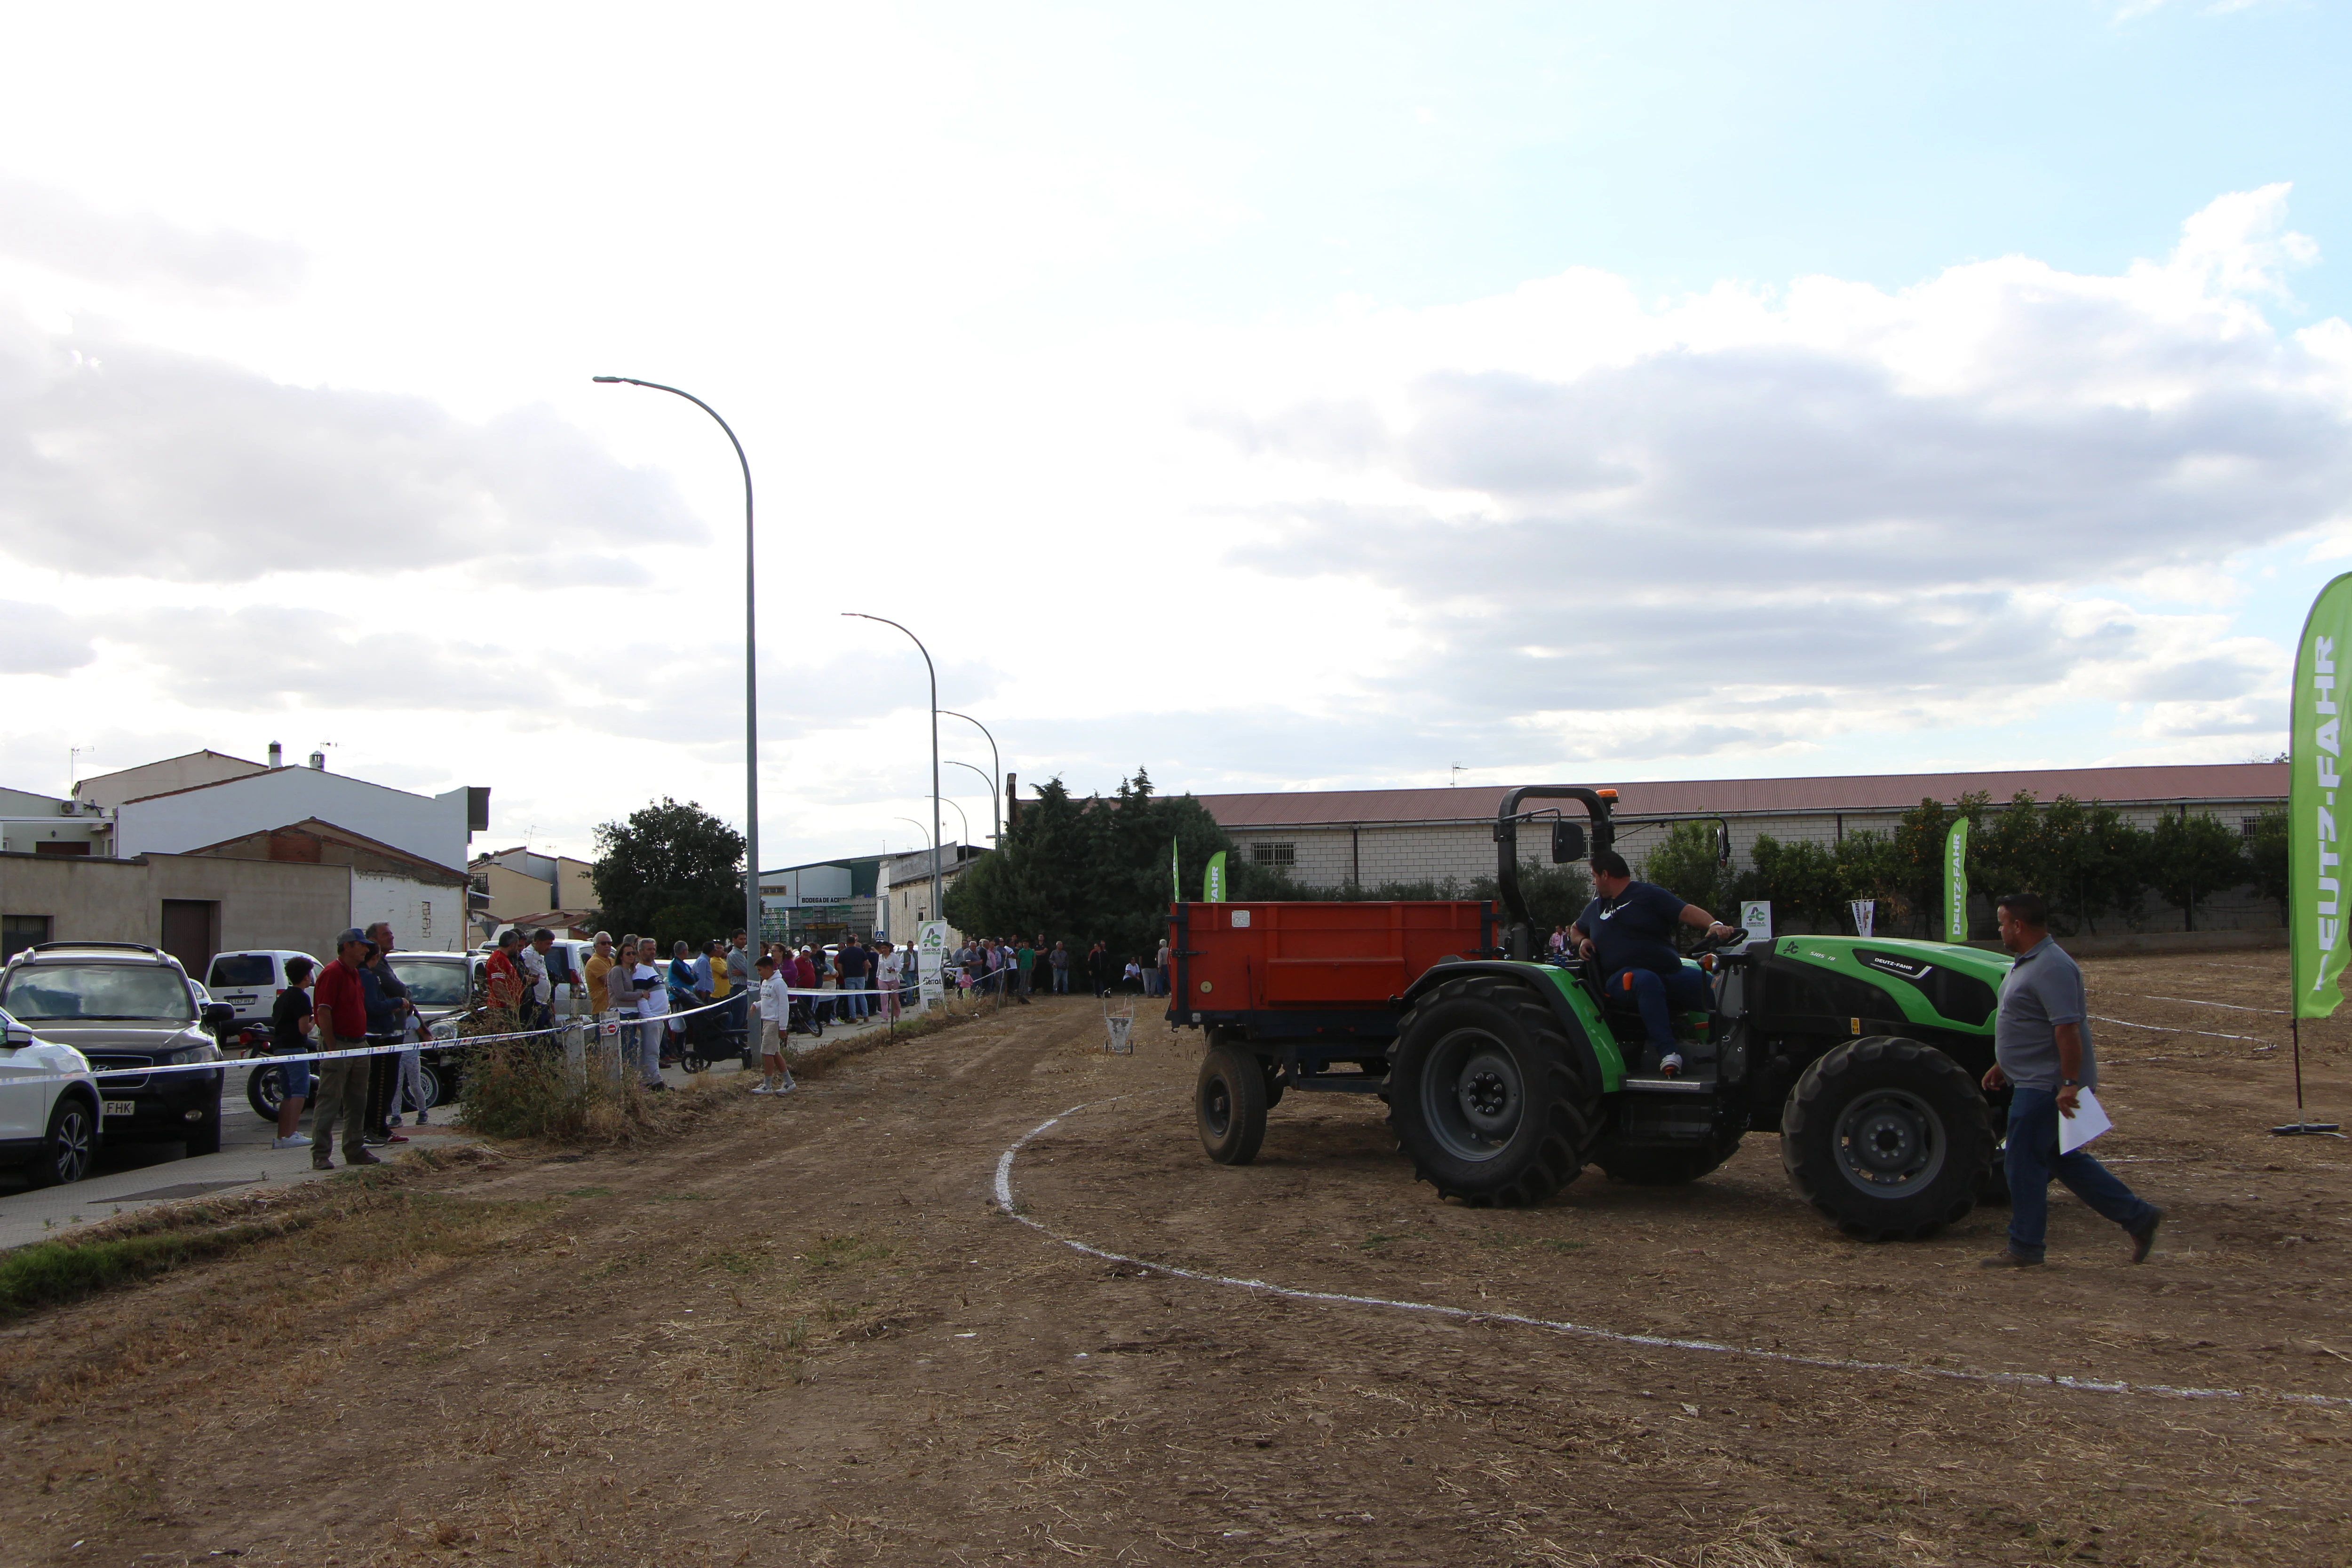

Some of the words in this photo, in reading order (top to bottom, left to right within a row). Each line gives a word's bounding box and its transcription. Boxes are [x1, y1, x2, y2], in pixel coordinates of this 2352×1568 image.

[1953, 834, 1961, 934] DEUTZ-FAHR
[1875, 957, 1913, 970] DEUTZ-FAHR
[107, 1102, 131, 1114] FHK
